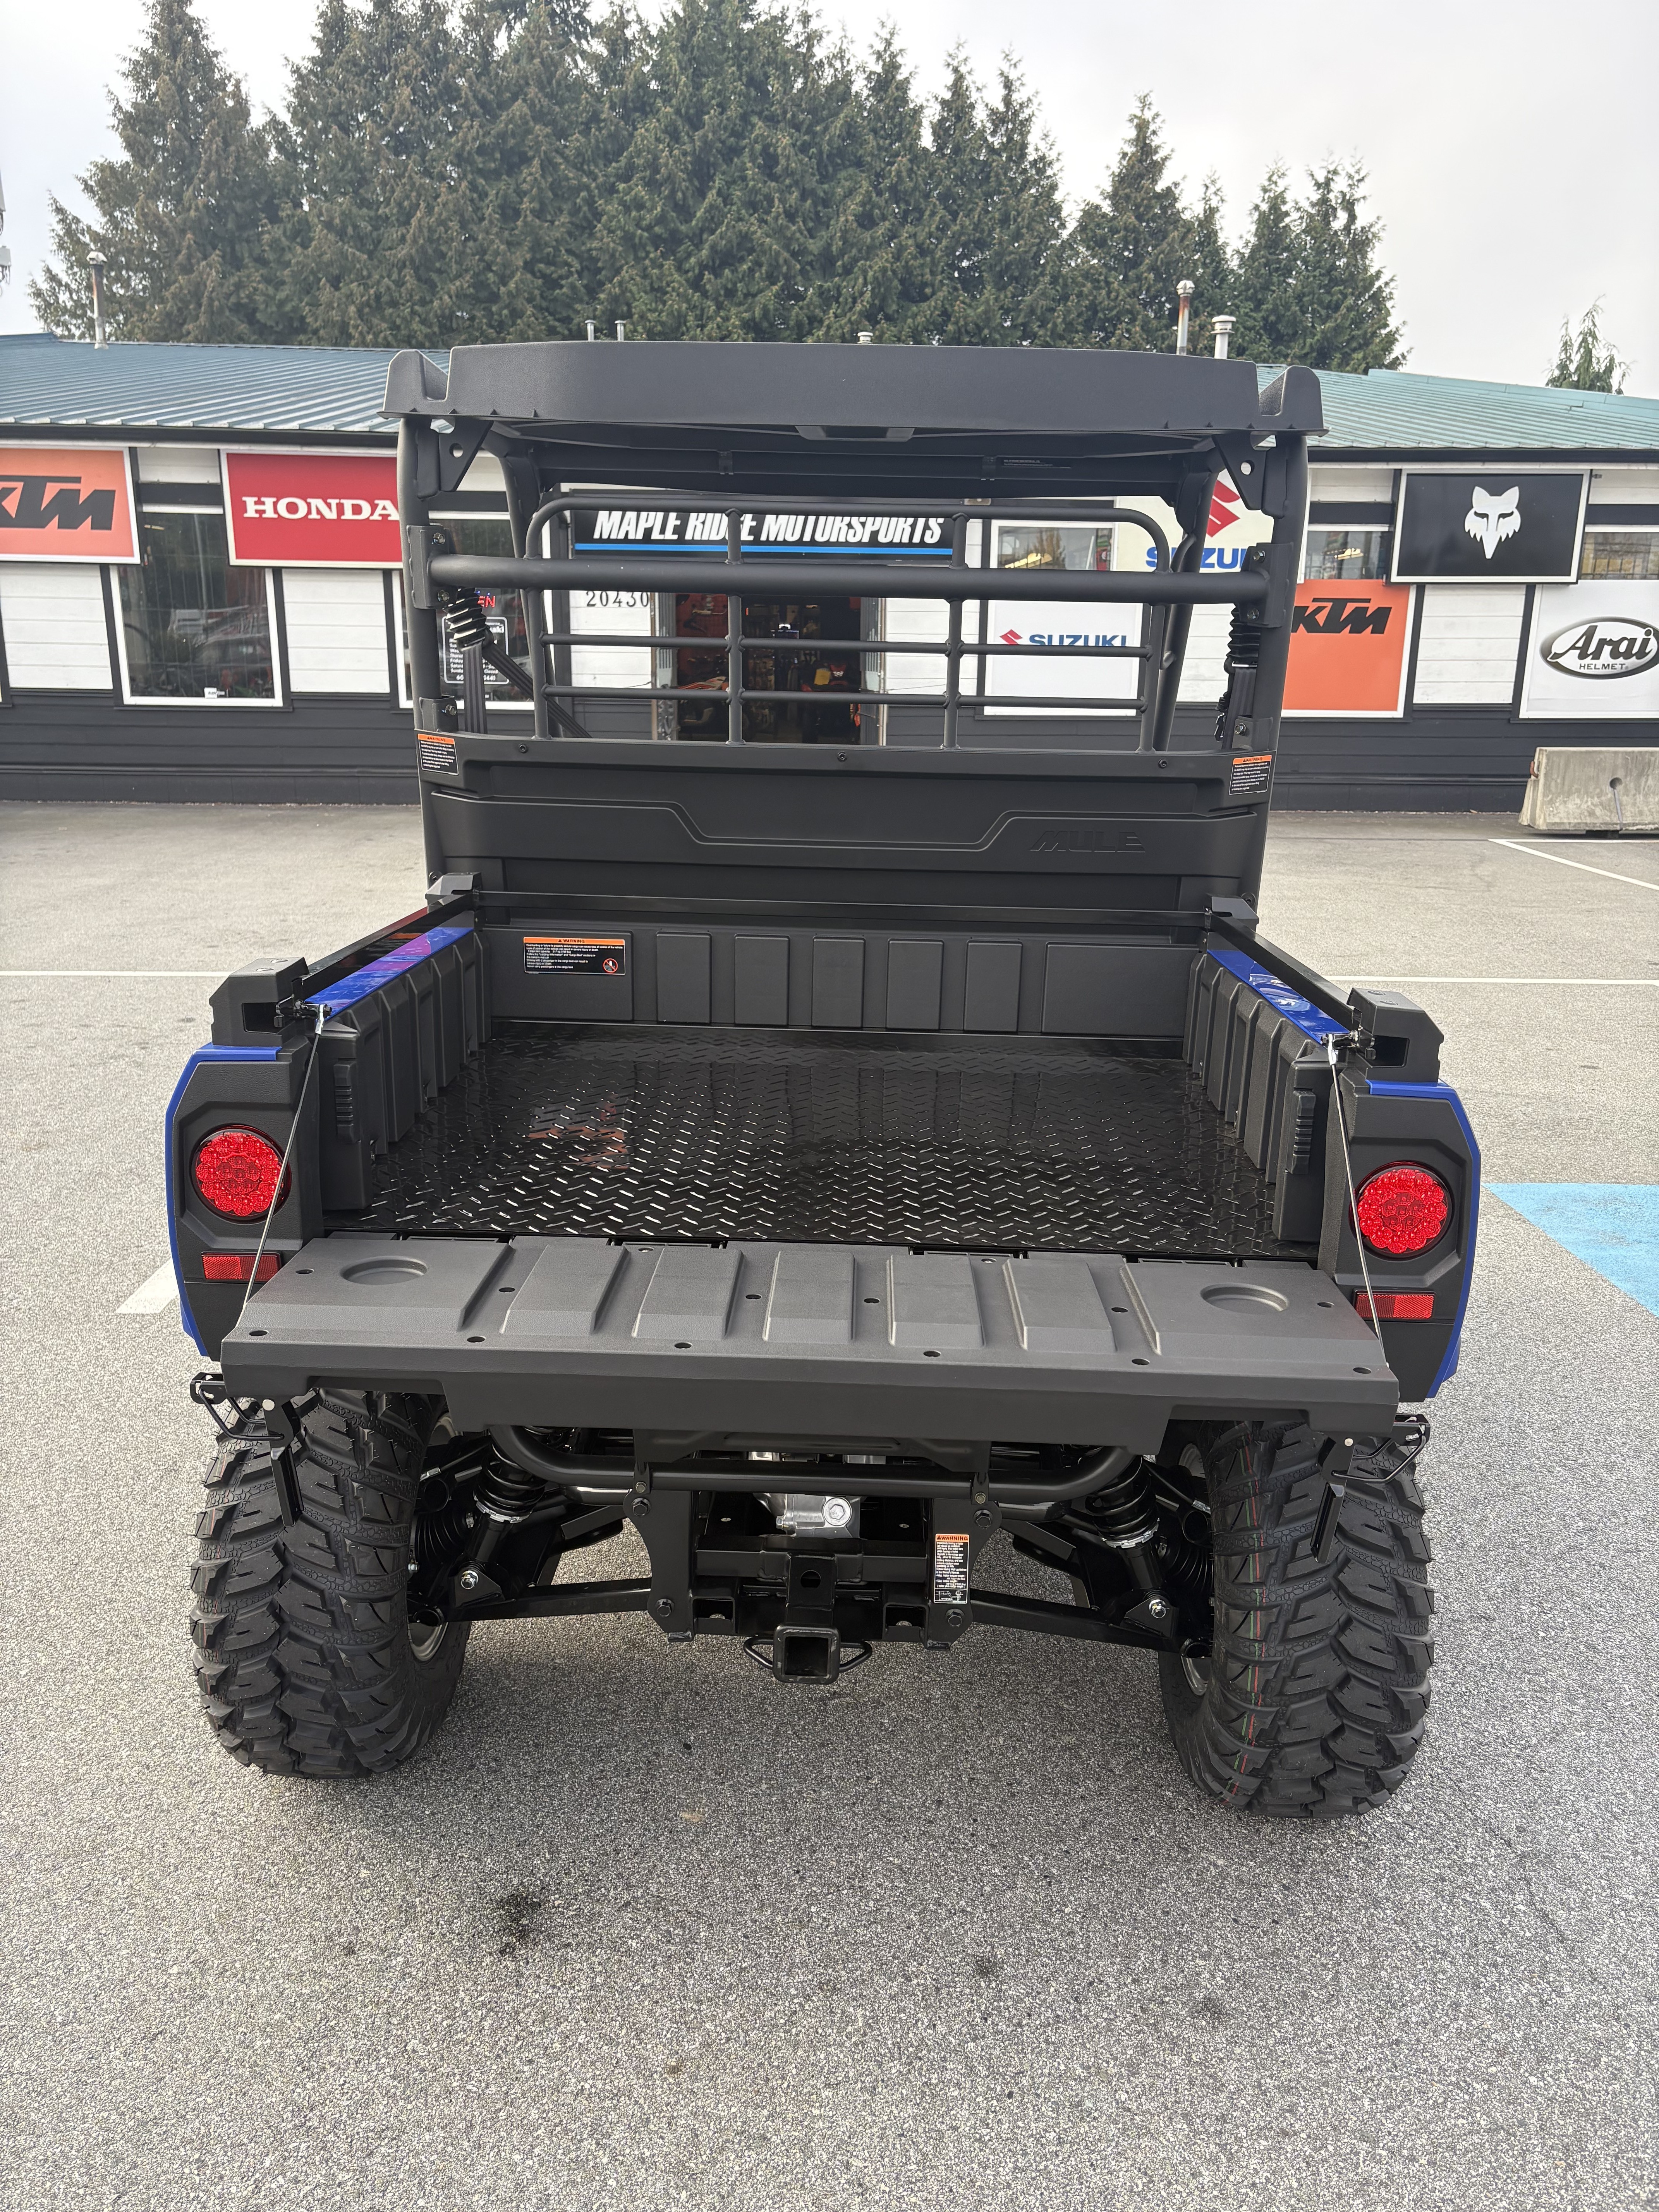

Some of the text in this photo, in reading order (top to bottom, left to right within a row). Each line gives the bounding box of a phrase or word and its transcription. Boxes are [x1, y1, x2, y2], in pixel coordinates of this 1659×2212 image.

[242, 497, 399, 520] HONDA
[593, 510, 681, 540] MAPLE
[760, 514, 945, 543] MOTORSPORTS
[586, 591, 649, 607] 20430
[1291, 598, 1393, 634] KTM
[1029, 634, 1127, 646] SUZUKI
[1549, 625, 1653, 660] Arai
[1029, 831, 1146, 853] MULE
